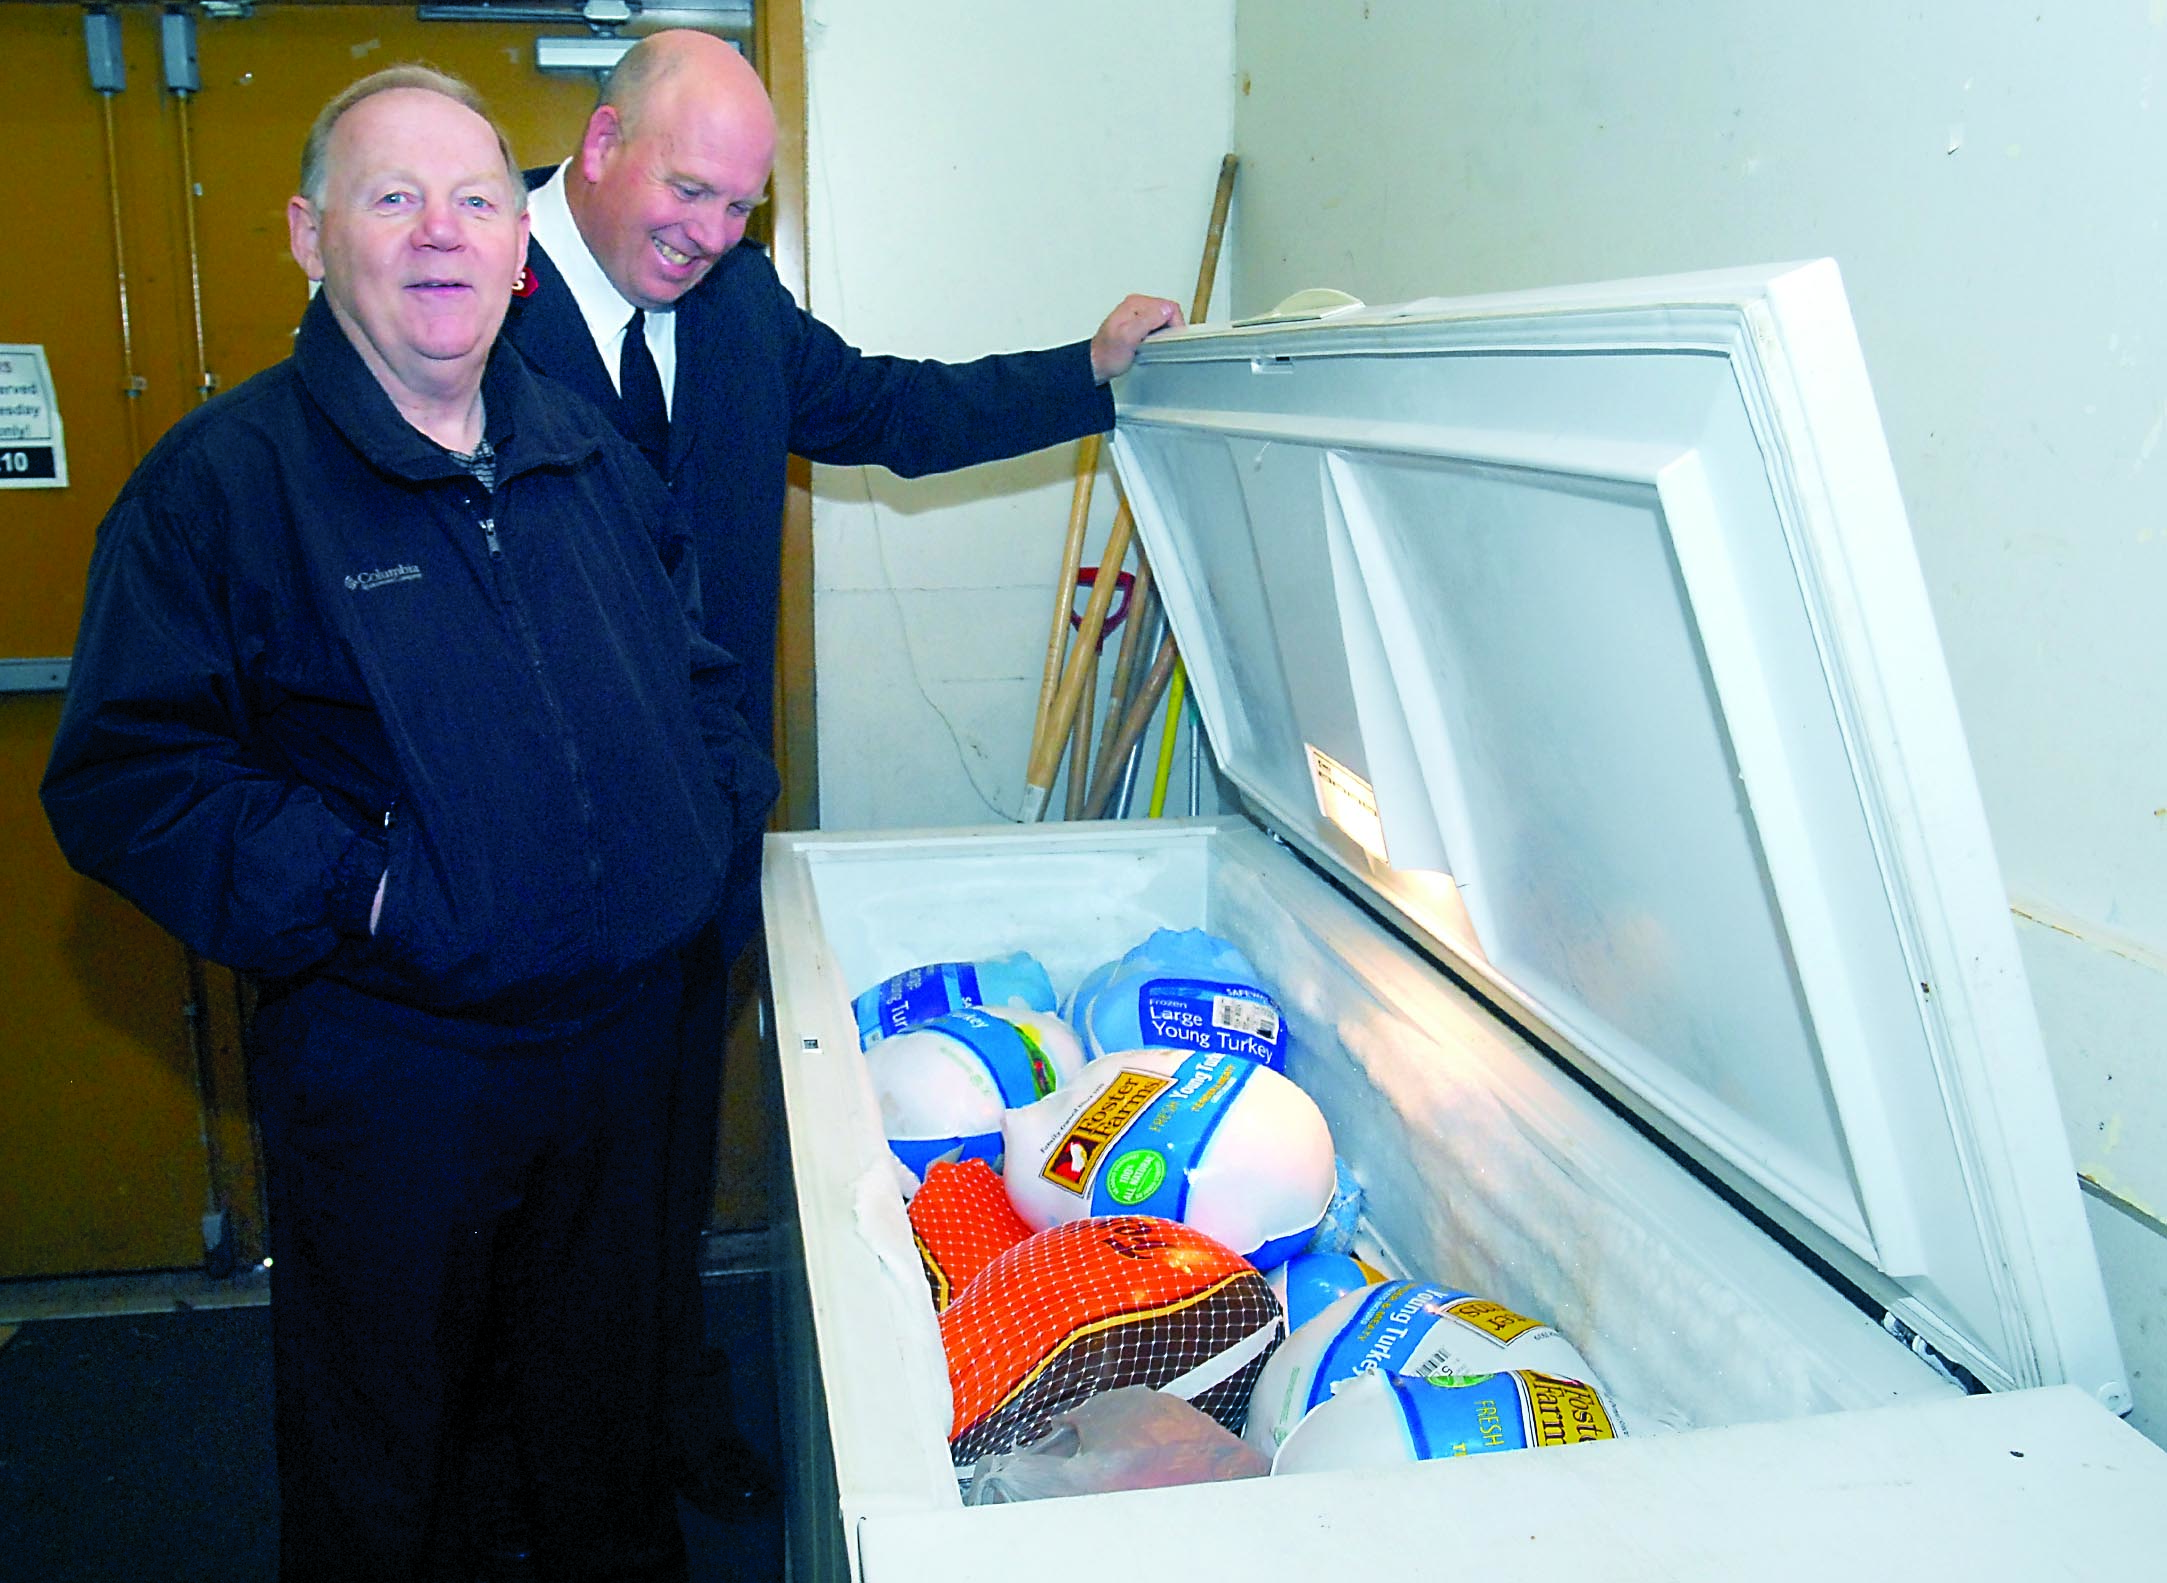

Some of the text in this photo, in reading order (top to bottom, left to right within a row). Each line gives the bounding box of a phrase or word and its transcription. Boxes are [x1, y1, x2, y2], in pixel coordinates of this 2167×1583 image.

[357, 564, 421, 584] Columbia
[1150, 998, 1188, 1009] Frozen
[1150, 1006, 1203, 1027] Large
[1152, 1020, 1211, 1049] Young
[1216, 1031, 1273, 1064] Turkey
[1168, 1071, 1213, 1099] Young
[1077, 1078, 1138, 1132] Foster
[1093, 1082, 1160, 1137] Farms
[1389, 1289, 1449, 1324] Young
[1473, 1400, 1505, 1447] FRESH
